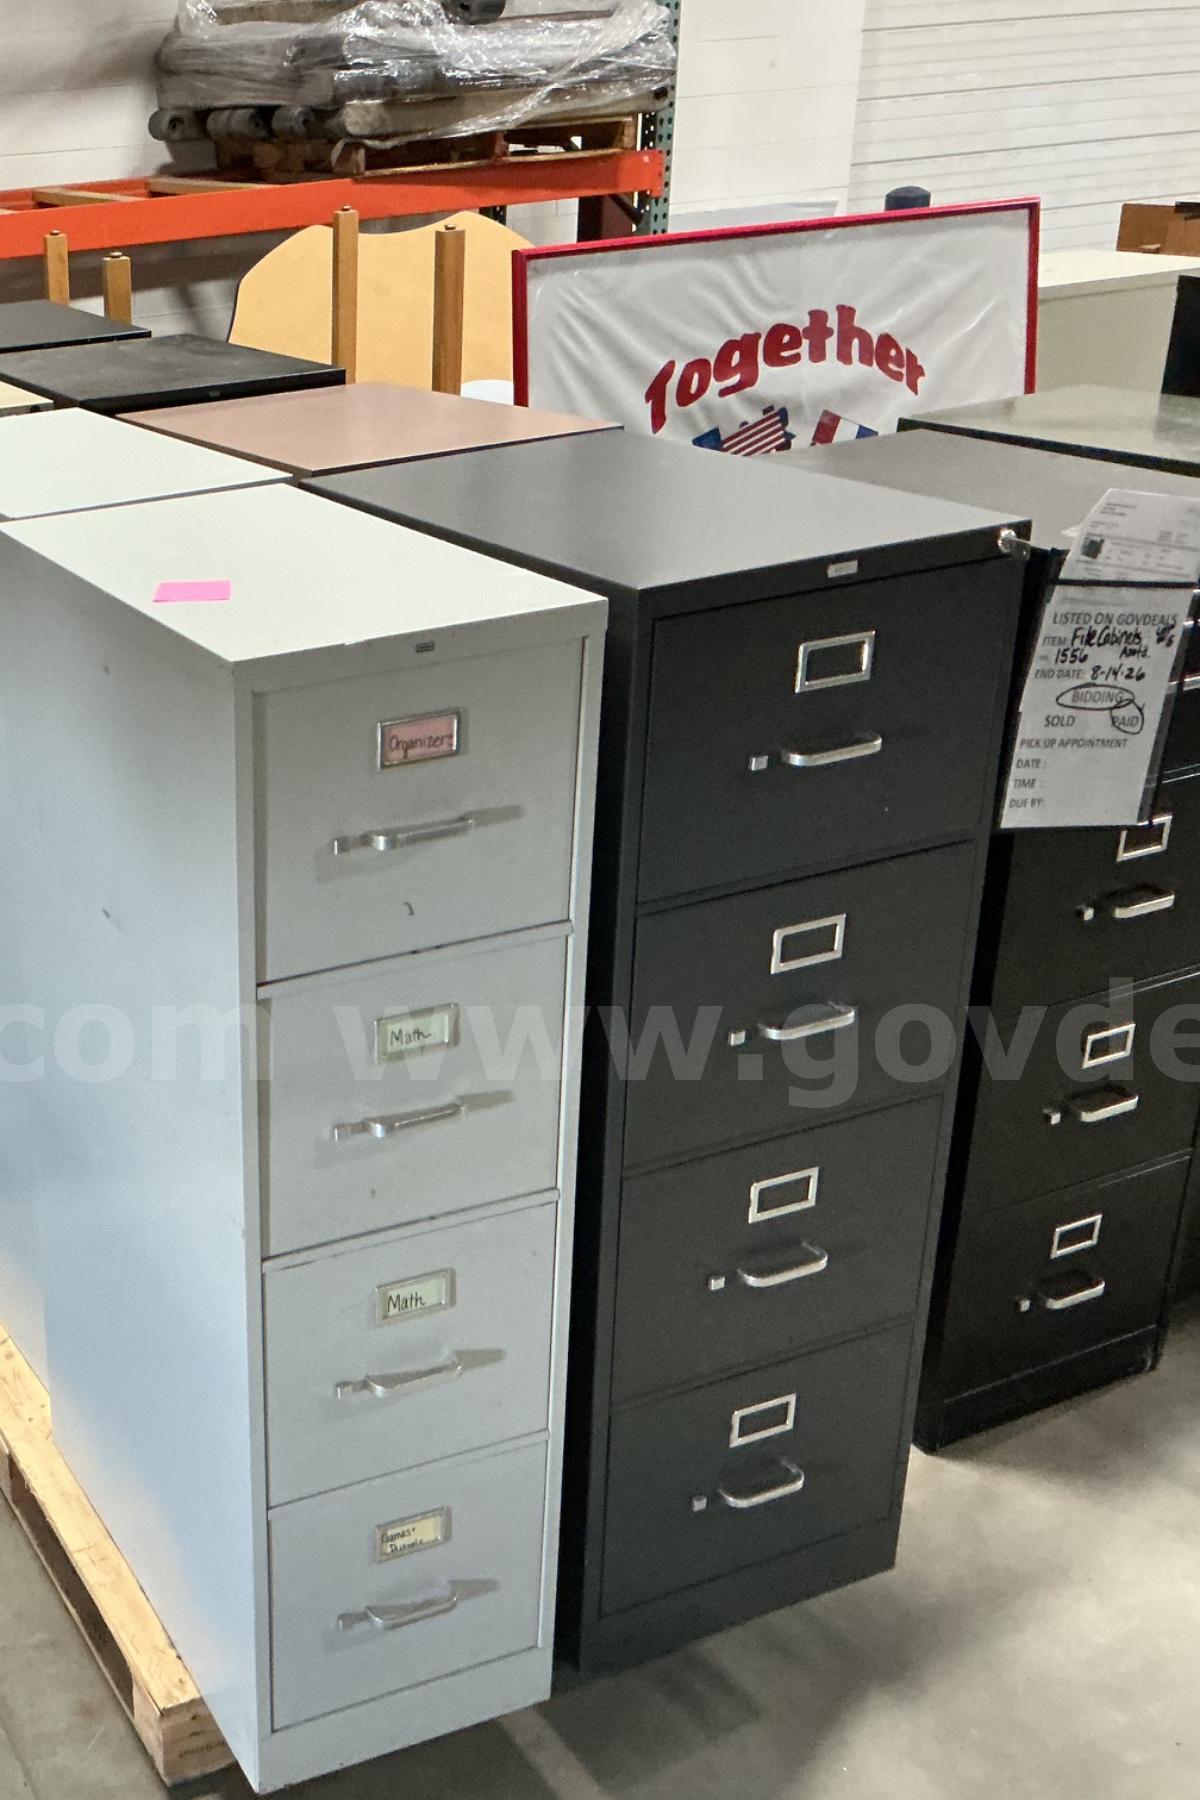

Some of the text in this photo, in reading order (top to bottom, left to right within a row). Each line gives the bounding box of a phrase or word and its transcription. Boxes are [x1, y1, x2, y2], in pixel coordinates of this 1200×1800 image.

[645, 304, 925, 434] Together
[1053, 613, 1179, 626] LISTED ON GOVDEALS
[1054, 648, 1089, 664] 1556
[1035, 668, 1056, 680] END
[1071, 690, 1125, 703] BIDDING
[1044, 714, 1139, 728] SOLD PAID
[1020, 738, 1128, 749] PICK UP APPOINTMENT
[1009, 798, 1029, 809] DUE
[390, 1027, 432, 1046] Math
[387, 1291, 426, 1313] Math
